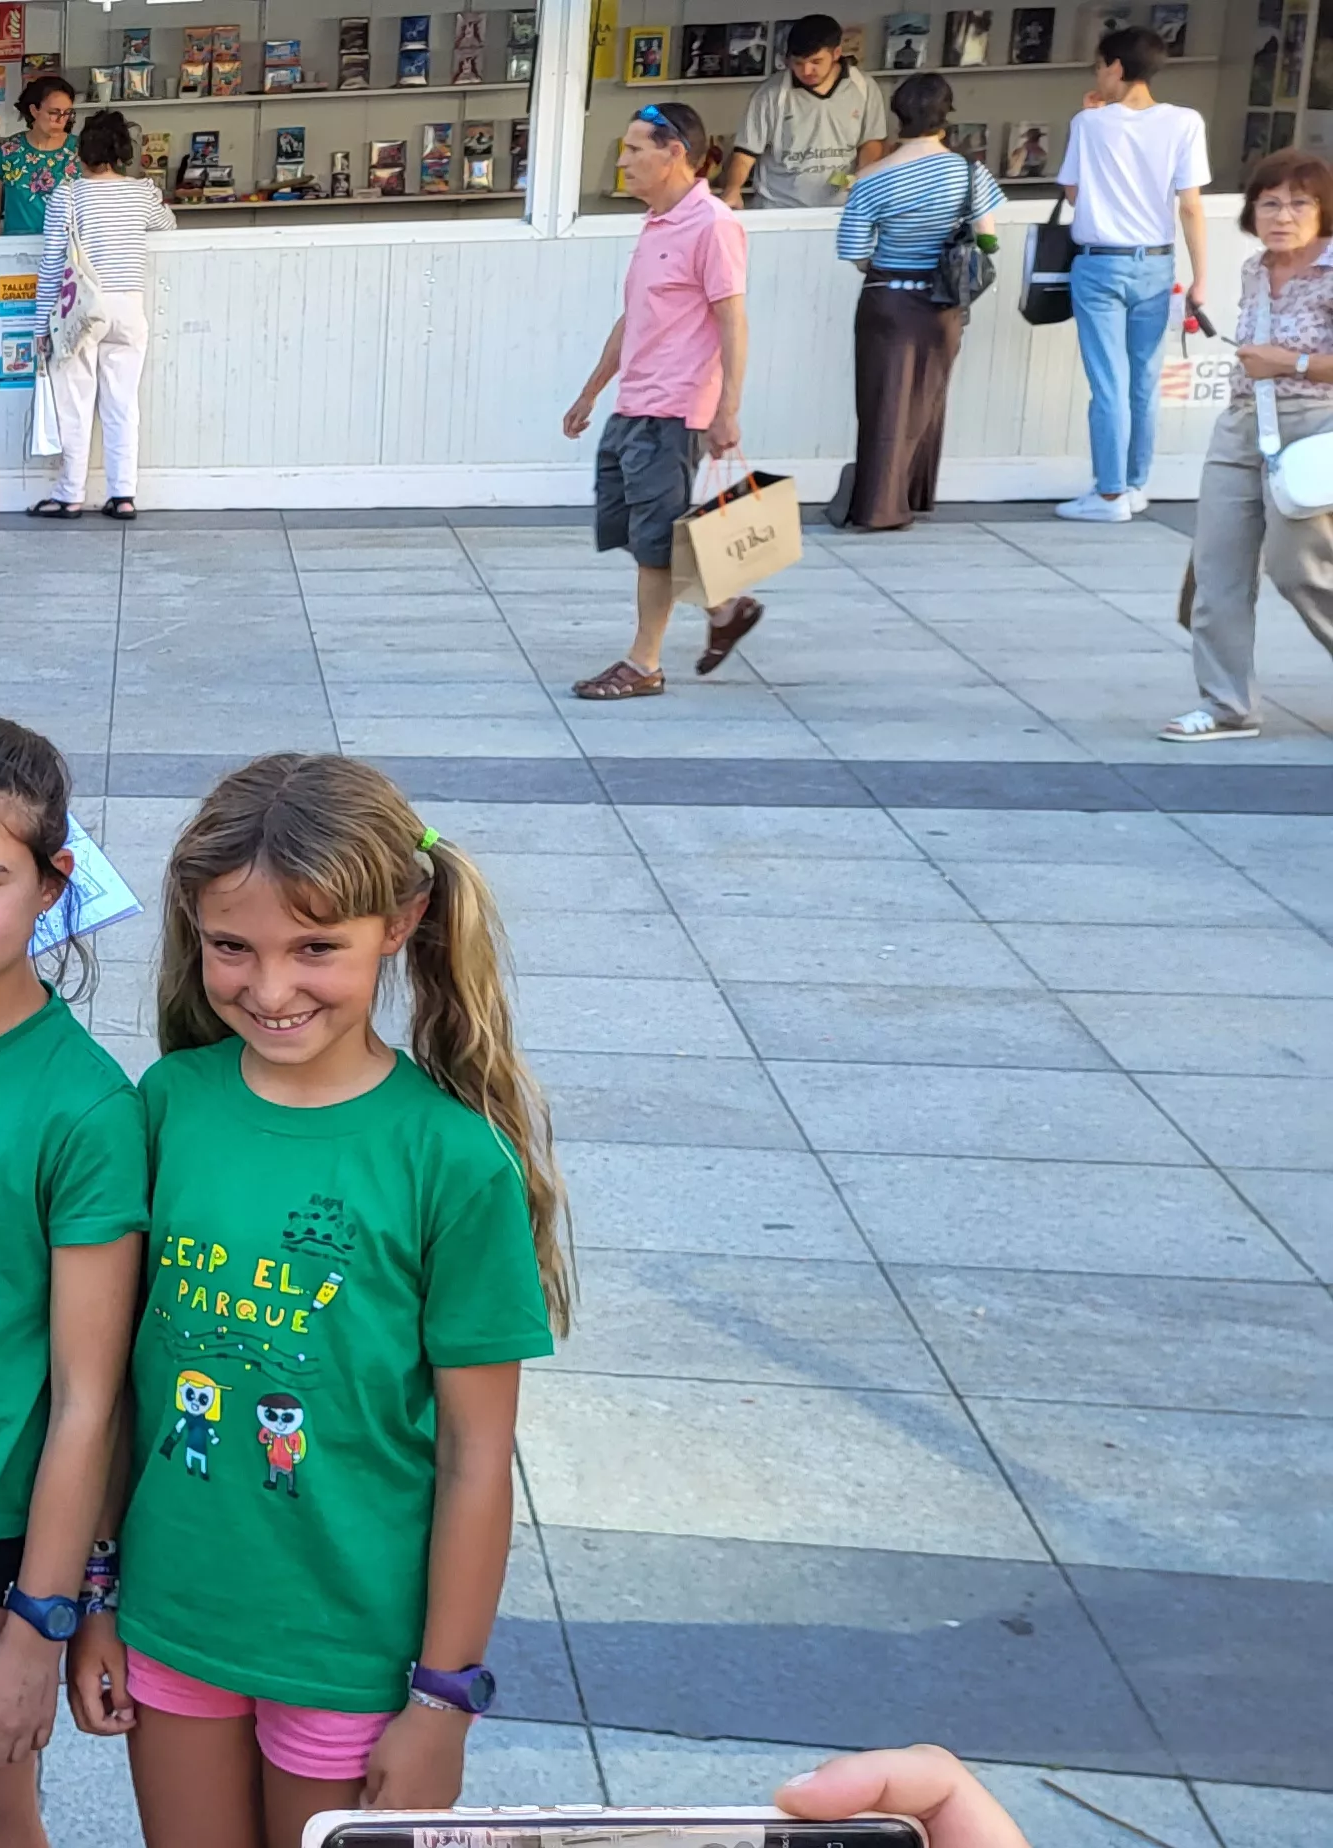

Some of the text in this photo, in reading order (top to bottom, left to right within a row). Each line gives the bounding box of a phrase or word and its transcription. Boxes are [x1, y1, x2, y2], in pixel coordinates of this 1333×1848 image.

[1194, 382, 1226, 400] DE
[253, 1257, 304, 1295] EL
[177, 1277, 311, 1334] PARQUE
